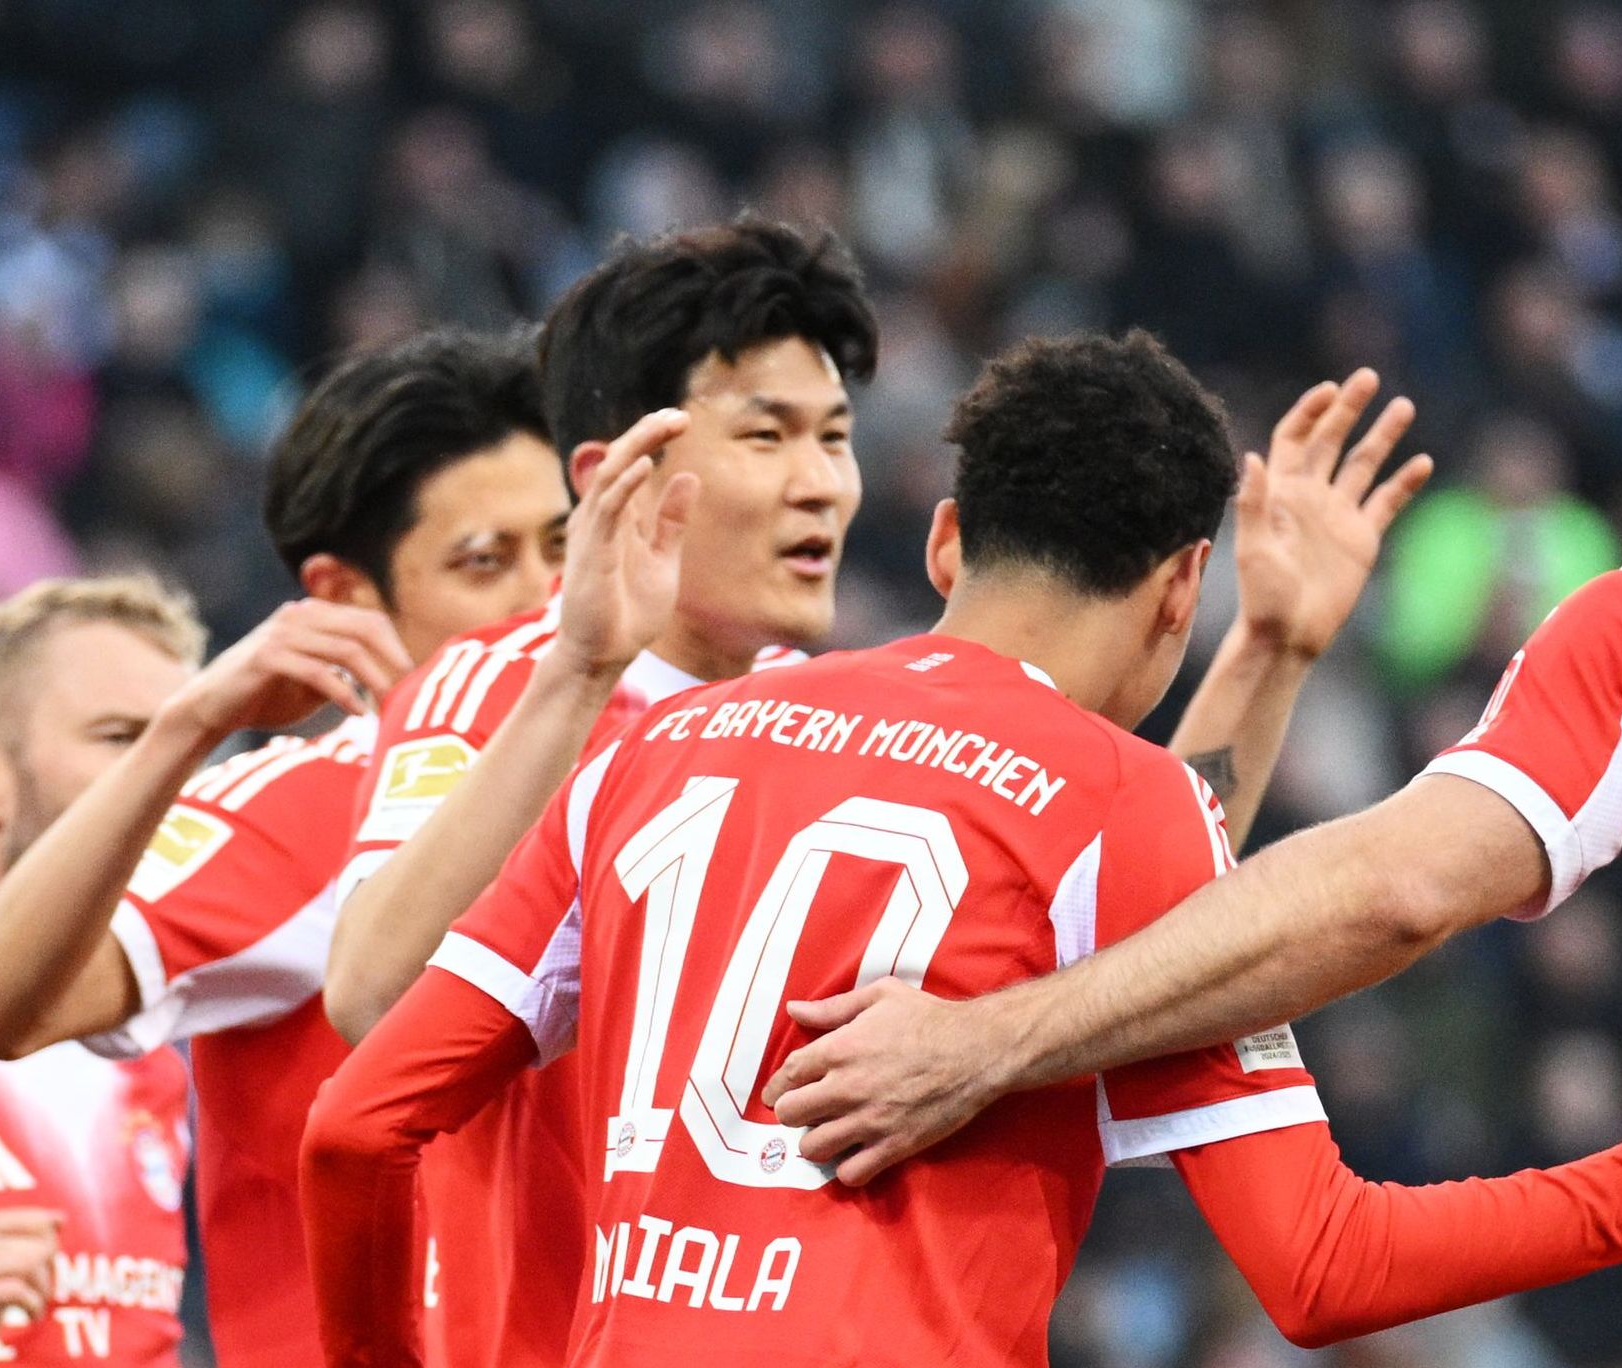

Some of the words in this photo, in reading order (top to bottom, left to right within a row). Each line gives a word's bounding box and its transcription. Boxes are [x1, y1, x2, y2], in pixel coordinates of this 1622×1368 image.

[644, 705, 708, 742] FC
[700, 700, 864, 754] BAYERN
[858, 718, 1067, 817] MÜNCHEN
[602, 776, 970, 1191] 10
[53, 1307, 111, 1360] TV
